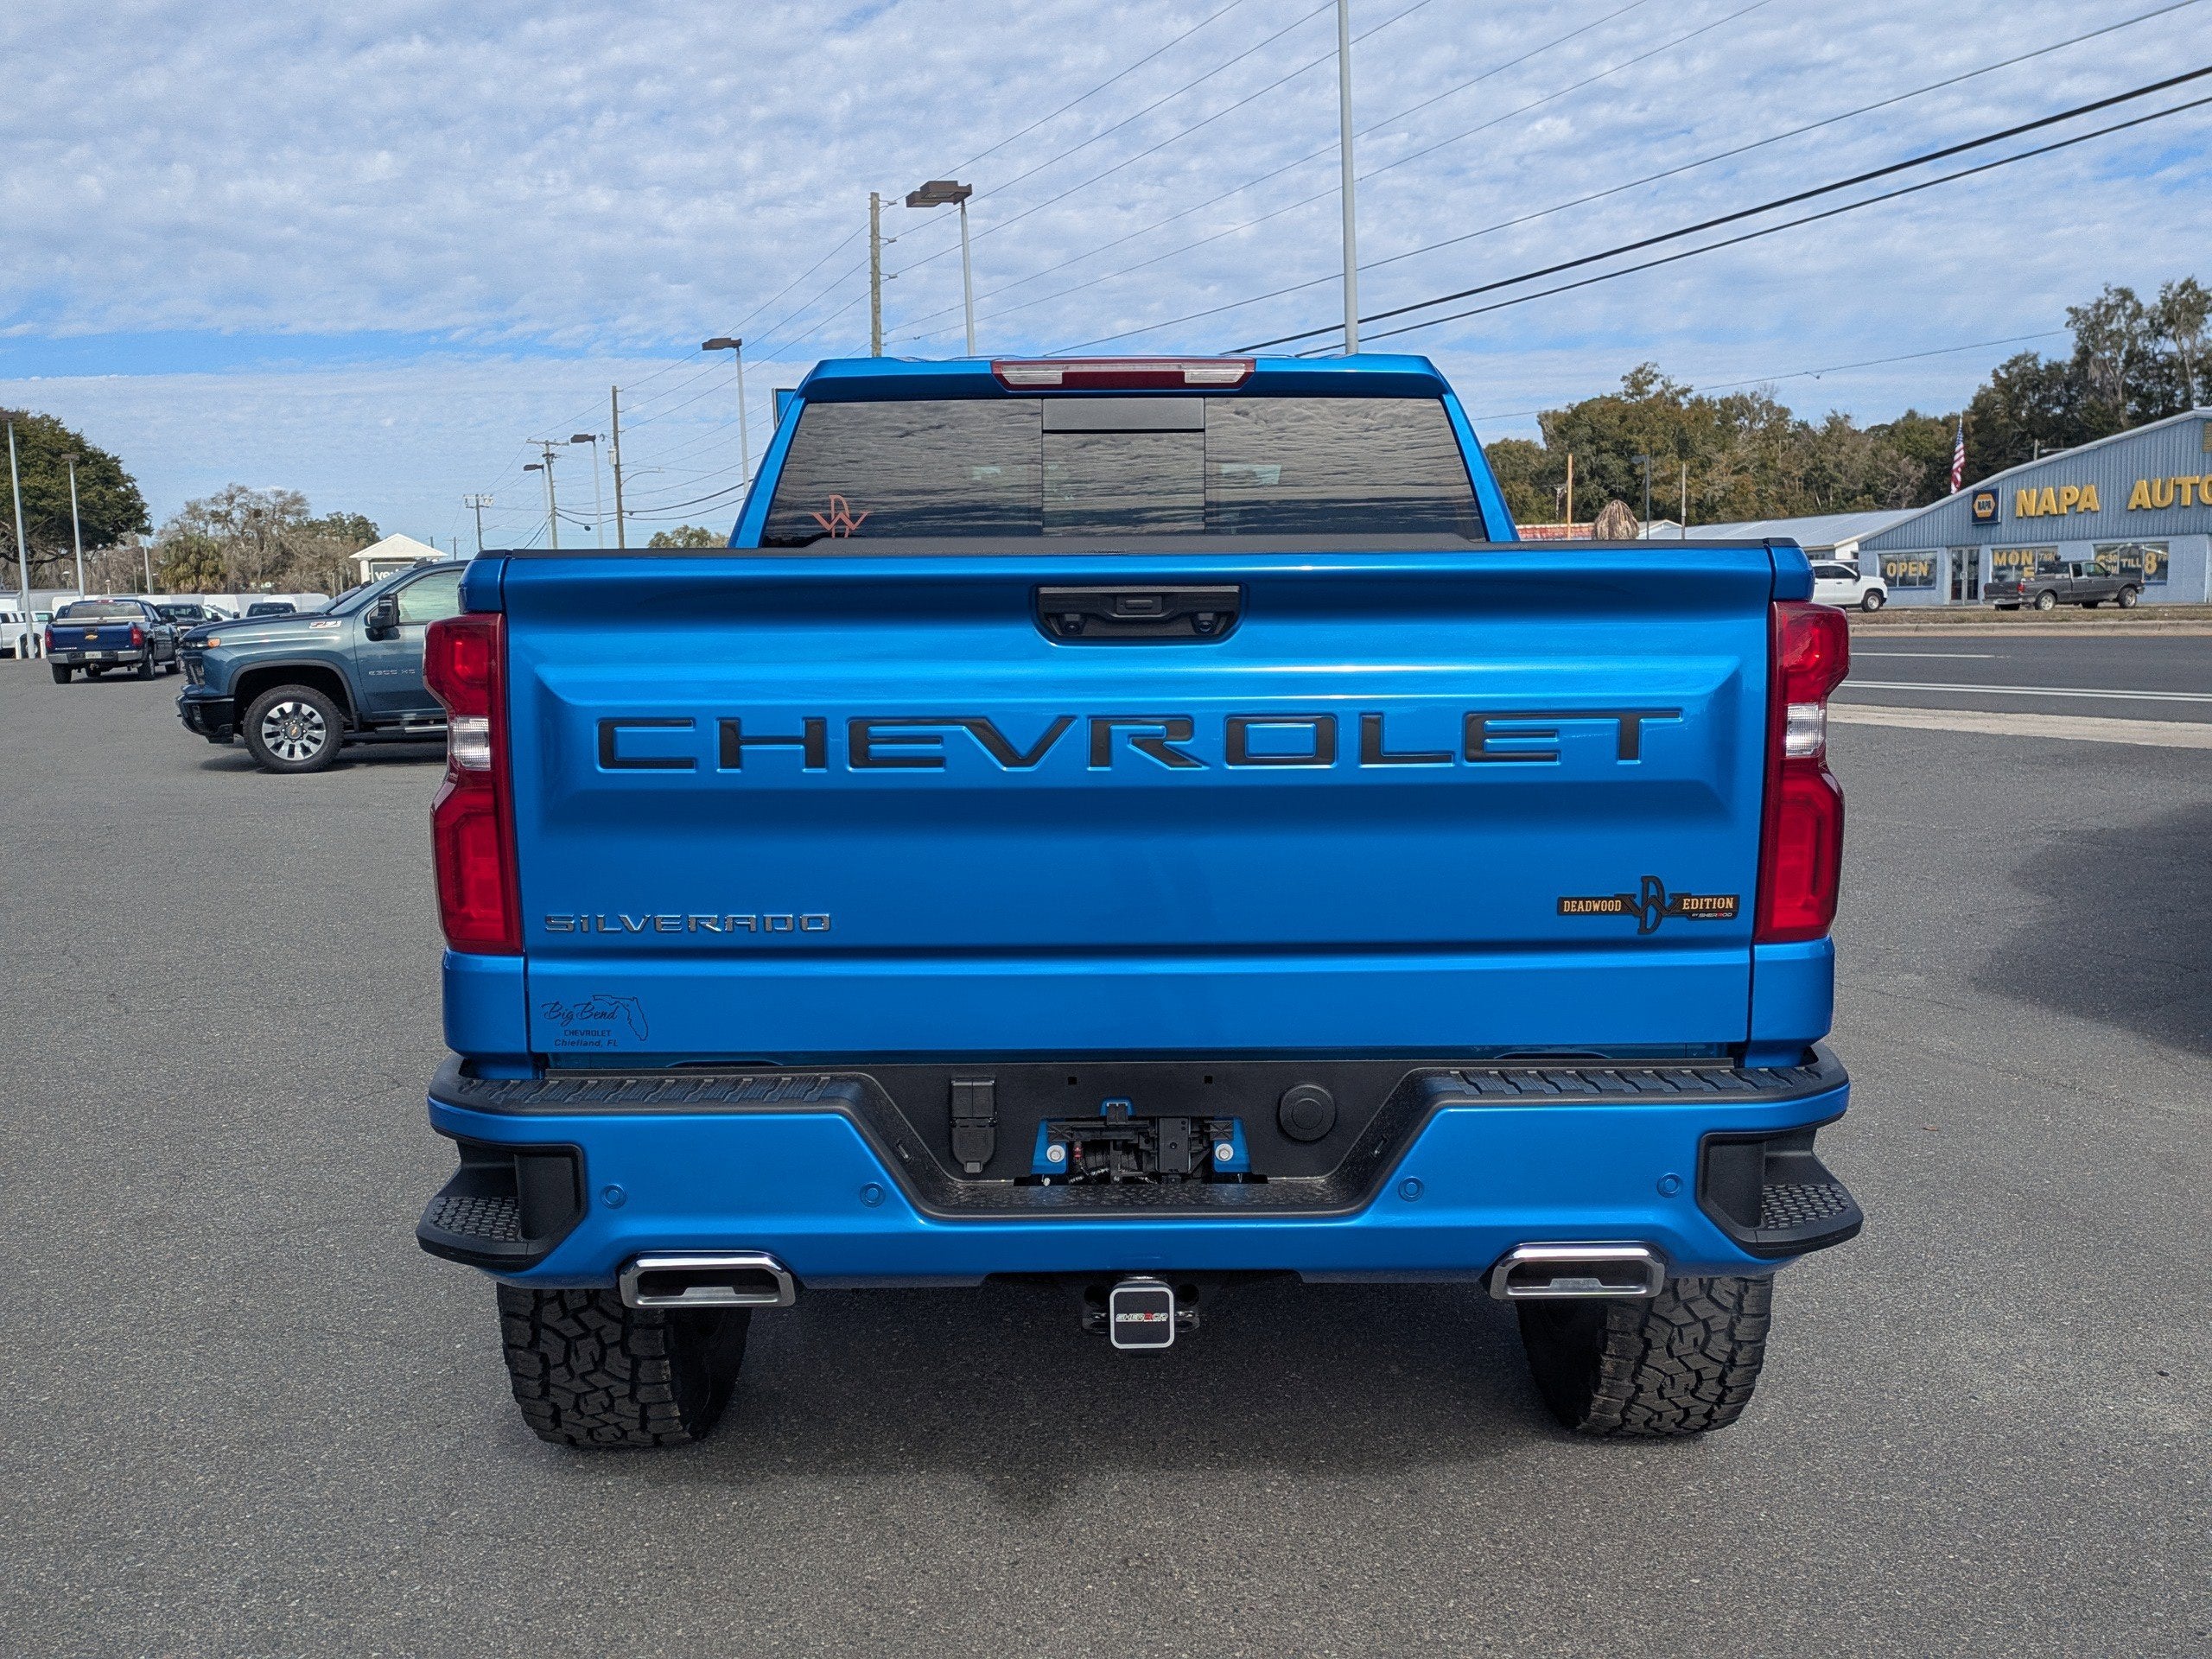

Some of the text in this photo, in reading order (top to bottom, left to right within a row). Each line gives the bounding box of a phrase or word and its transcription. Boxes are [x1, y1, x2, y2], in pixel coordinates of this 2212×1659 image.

[2016, 484, 2100, 518] NAPA
[1993, 549, 2033, 567] MON
[2120, 557, 2142, 569] TILL
[2145, 551, 2158, 575] 8
[1886, 561, 1929, 578] OPEN
[596, 709, 1683, 772] CHEVROLET
[1563, 897, 1734, 912] DEADWOOD EDITION
[545, 913, 831, 932] SILVERADO
[540, 1001, 620, 1027] Big Bend
[564, 1029, 612, 1038] CHEVROLET
[554, 1039, 620, 1048] Chiefland, FL
